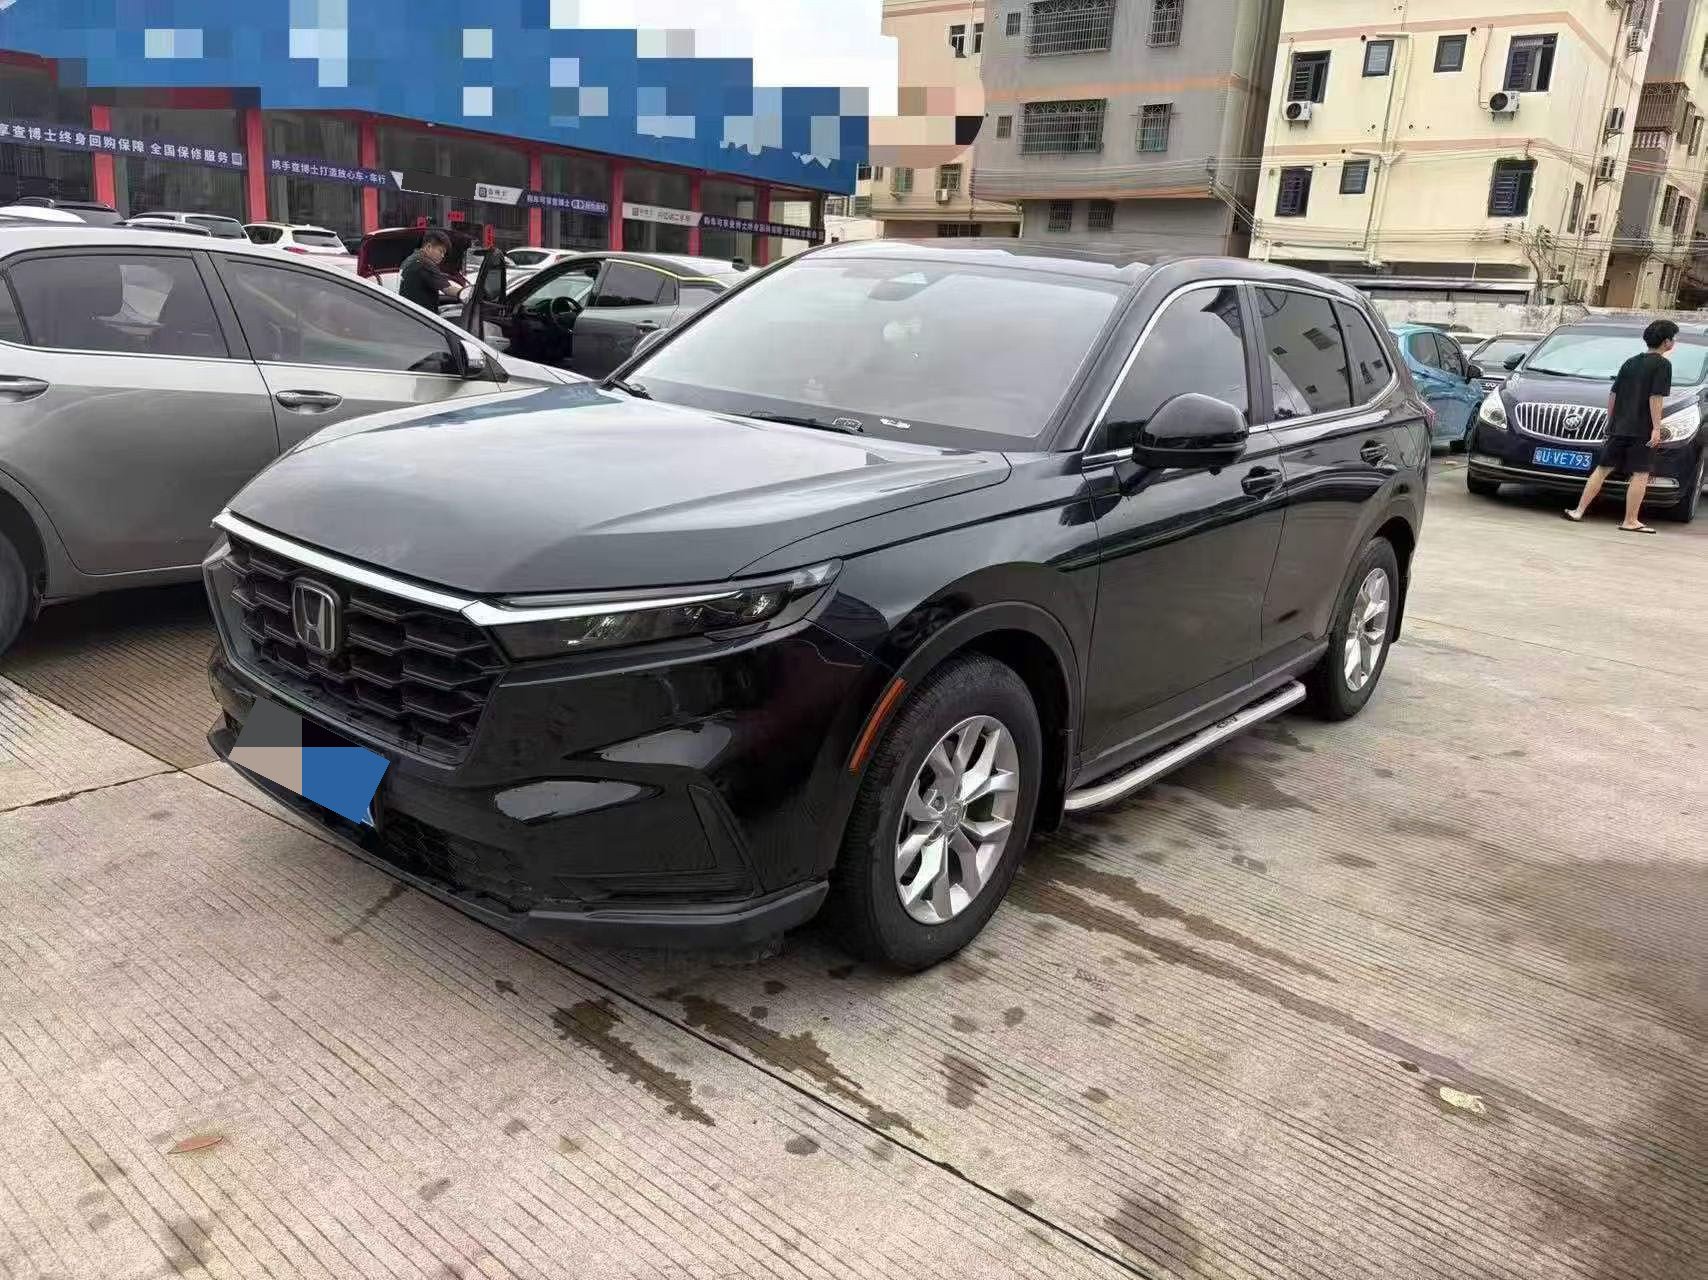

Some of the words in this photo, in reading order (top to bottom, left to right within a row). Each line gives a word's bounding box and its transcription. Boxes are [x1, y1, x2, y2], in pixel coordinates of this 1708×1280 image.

[0, 123, 145, 152] 享查博士终身回购保障
[150, 143, 228, 163] 全国保修服务
